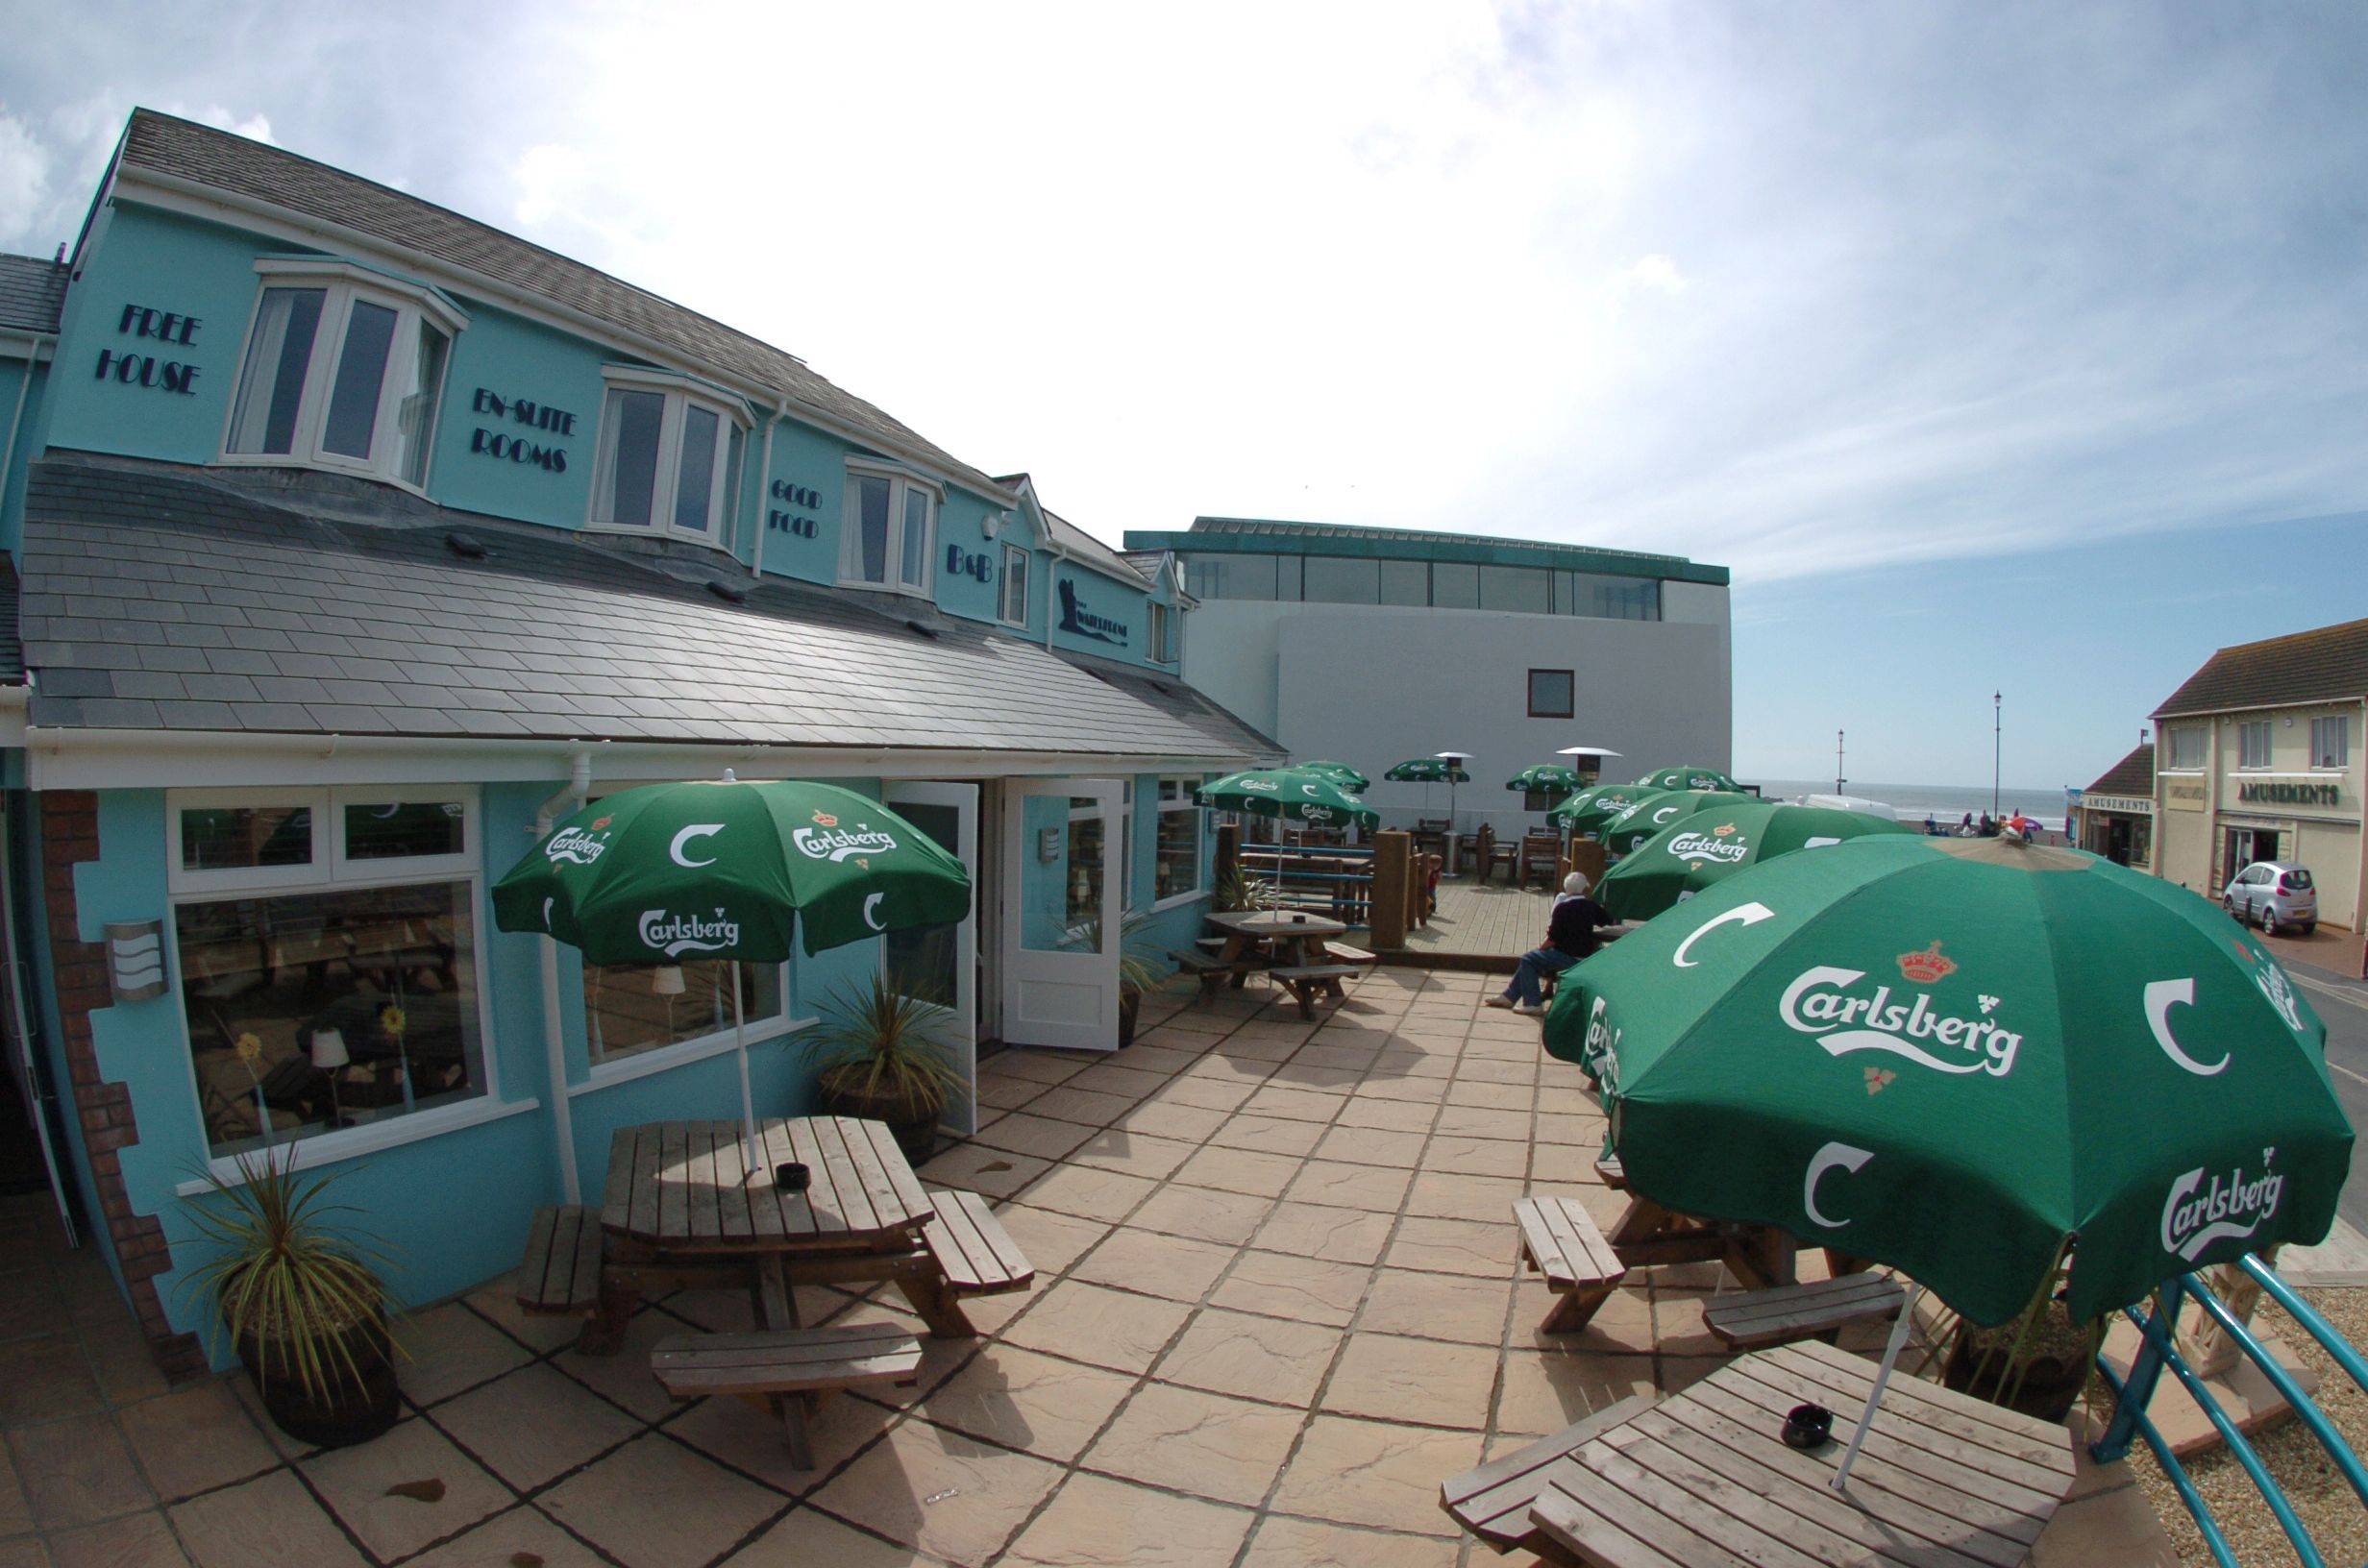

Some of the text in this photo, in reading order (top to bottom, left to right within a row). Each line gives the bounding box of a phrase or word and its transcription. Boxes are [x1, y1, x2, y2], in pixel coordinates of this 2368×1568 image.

[119, 304, 202, 346] FREE
[95, 349, 202, 395] HOUSE
[473, 387, 578, 436] EN-SUITE
[471, 428, 568, 473] ROOMS
[772, 479, 823, 509] GOOD
[770, 509, 819, 539] FOOD
[947, 544, 993, 583] B&B
[2088, 798, 2150, 812] AMUSEMENTS
[2237, 782, 2339, 805] AMUSEMENTS
[546, 827, 611, 864] Carlsberg
[670, 824, 726, 868] C
[793, 823, 897, 863] Carlsberg
[1667, 832, 1747, 862] Carlsberg
[639, 908, 739, 957] Carlsberg
[1779, 966, 2022, 1076] Carlsberg
[2143, 977, 2231, 1076] C
[2161, 1148, 2284, 1262] Carlsberg
